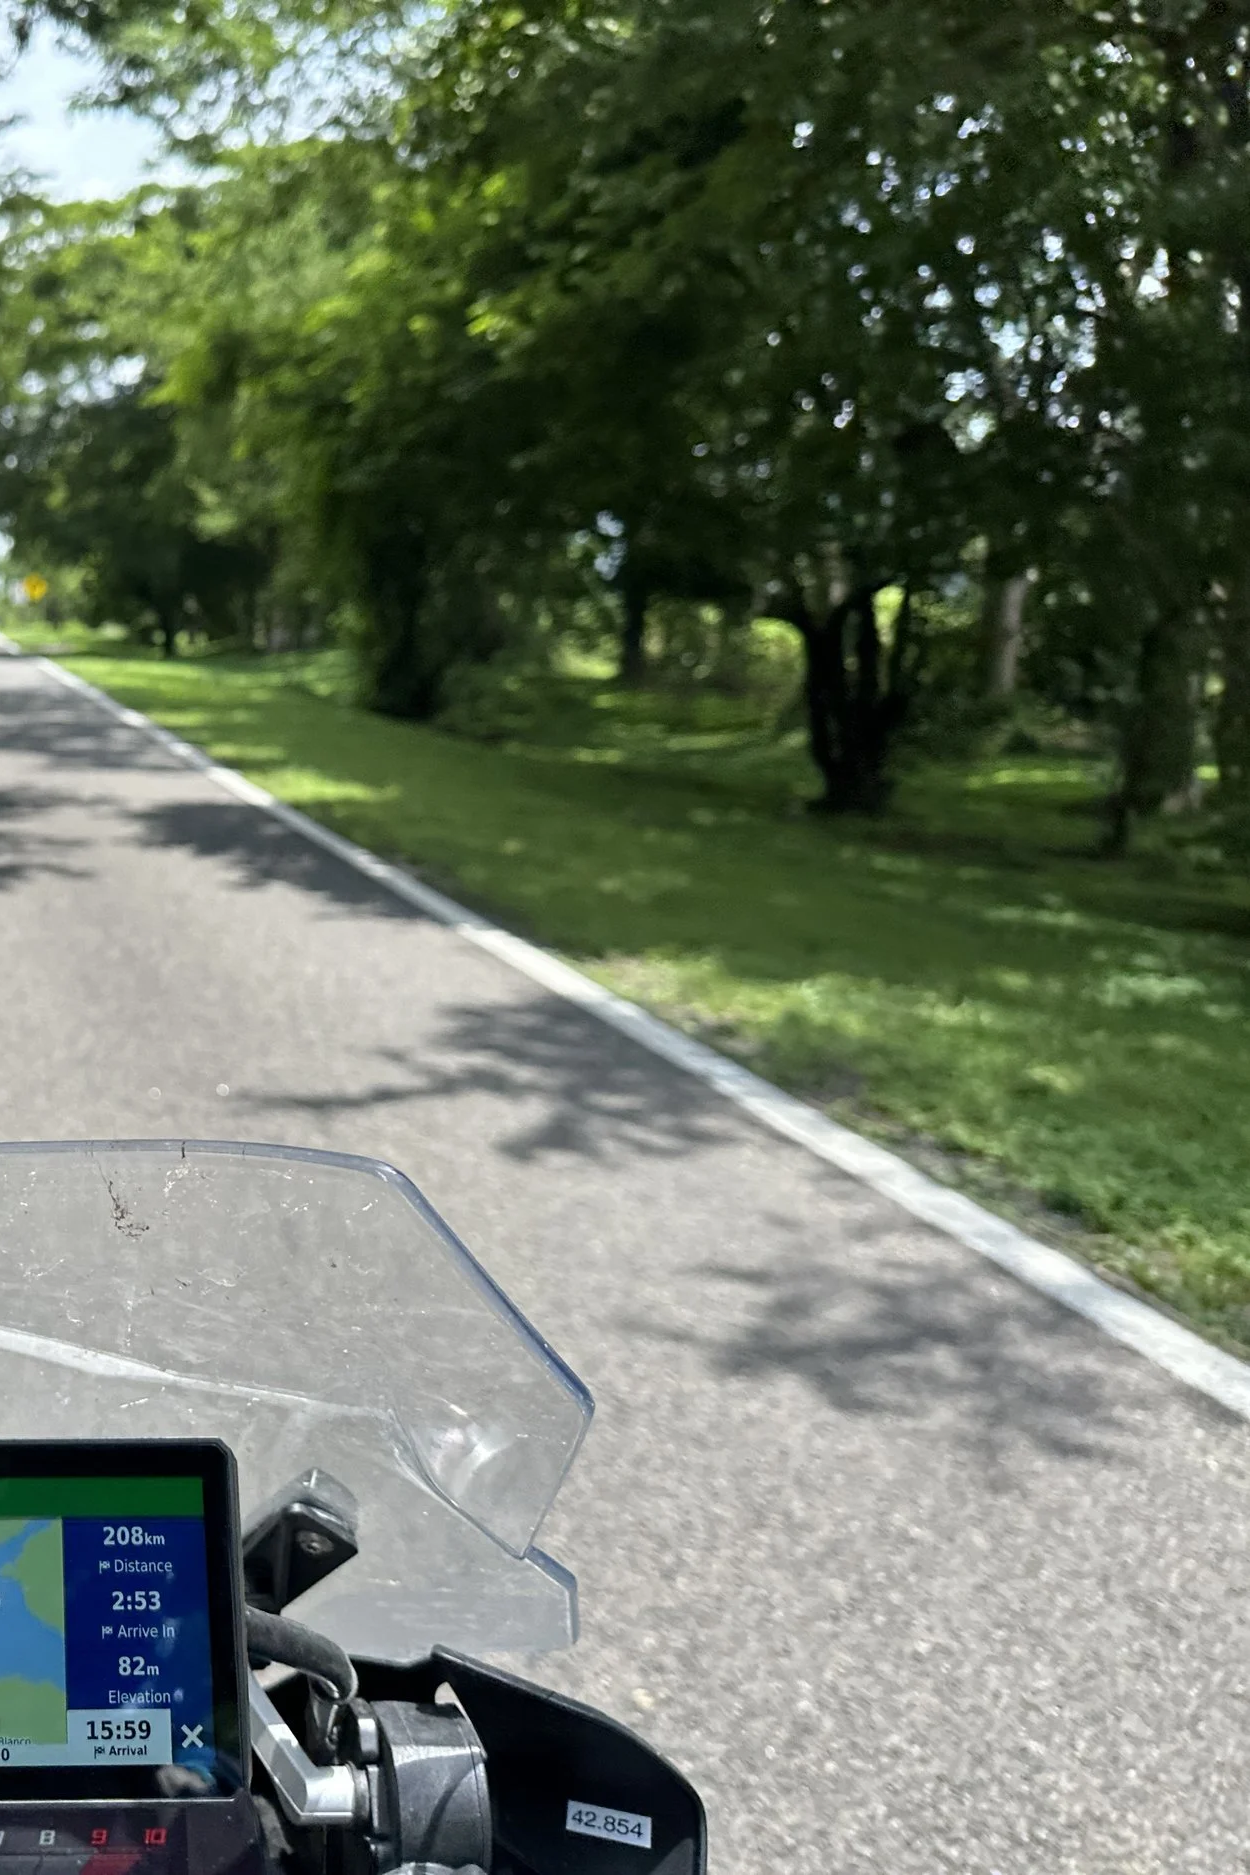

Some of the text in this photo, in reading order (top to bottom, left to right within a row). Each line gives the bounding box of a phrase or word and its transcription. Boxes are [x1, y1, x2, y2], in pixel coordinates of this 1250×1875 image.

[114, 1559, 173, 1573] Distance
[112, 1591, 161, 1611] 2:53
[118, 1624, 176, 1638] Arrive In
[108, 1690, 171, 1704] Elevation
[87, 1720, 152, 1740] 15:59
[109, 1745, 147, 1756] Arrival
[571, 1808, 644, 1839] 42.854
[39, 1829, 56, 1845] 8
[90, 1828, 108, 1845] 9
[143, 1828, 167, 1845] 10
